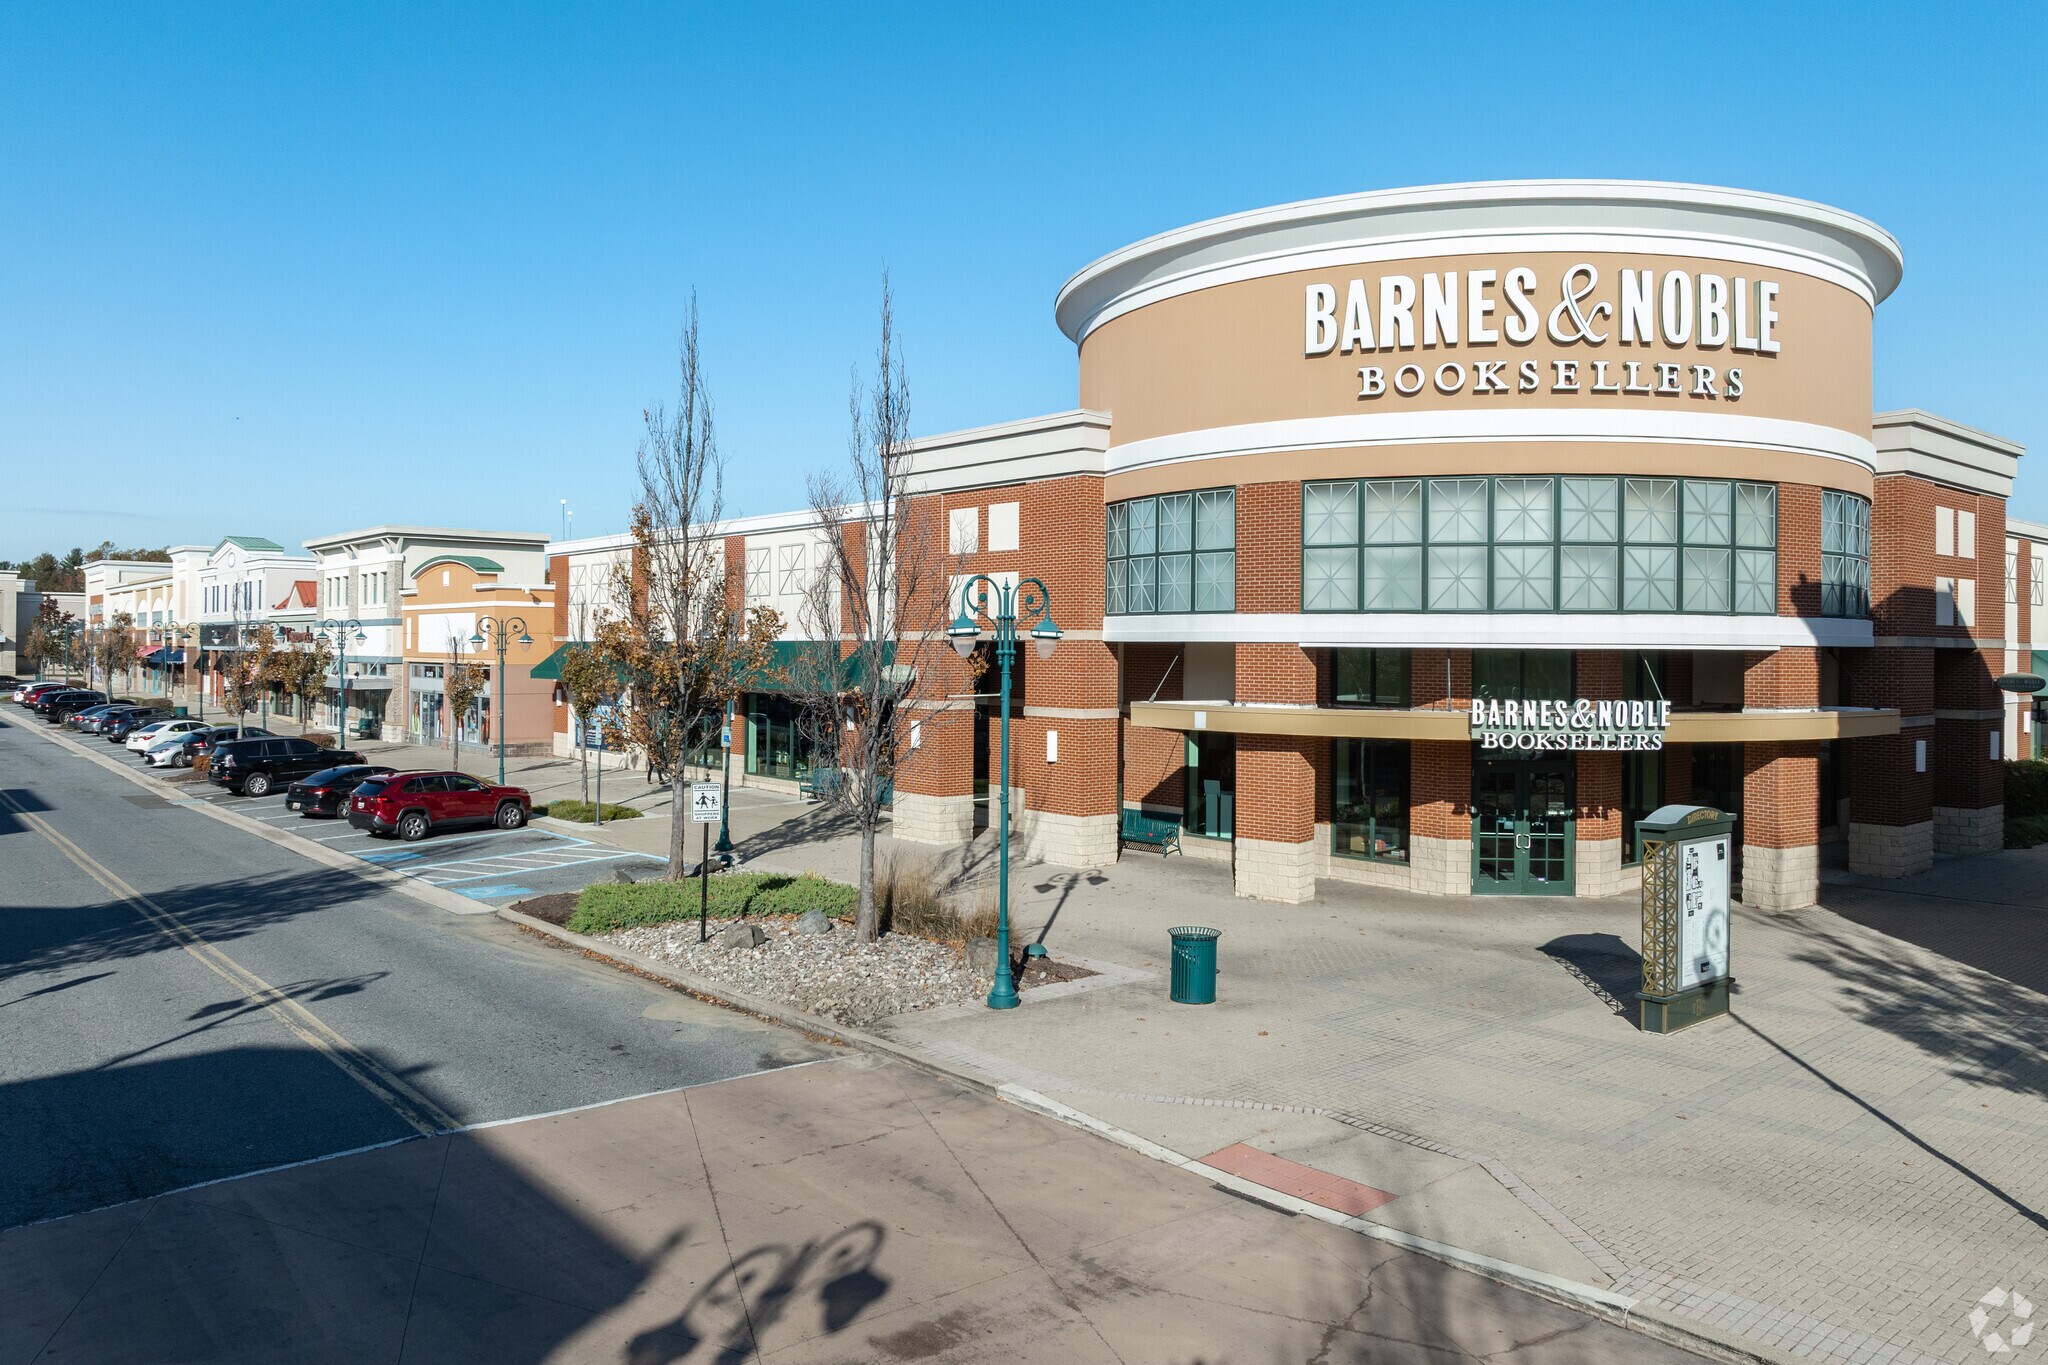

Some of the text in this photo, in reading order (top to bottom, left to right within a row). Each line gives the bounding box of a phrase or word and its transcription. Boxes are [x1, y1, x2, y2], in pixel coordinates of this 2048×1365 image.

[1358, 360, 1744, 399] BOOKSELLERS
[1481, 732, 1663, 750] BOOKSELLERS
[1687, 810, 1718, 824] DIRECTORY
